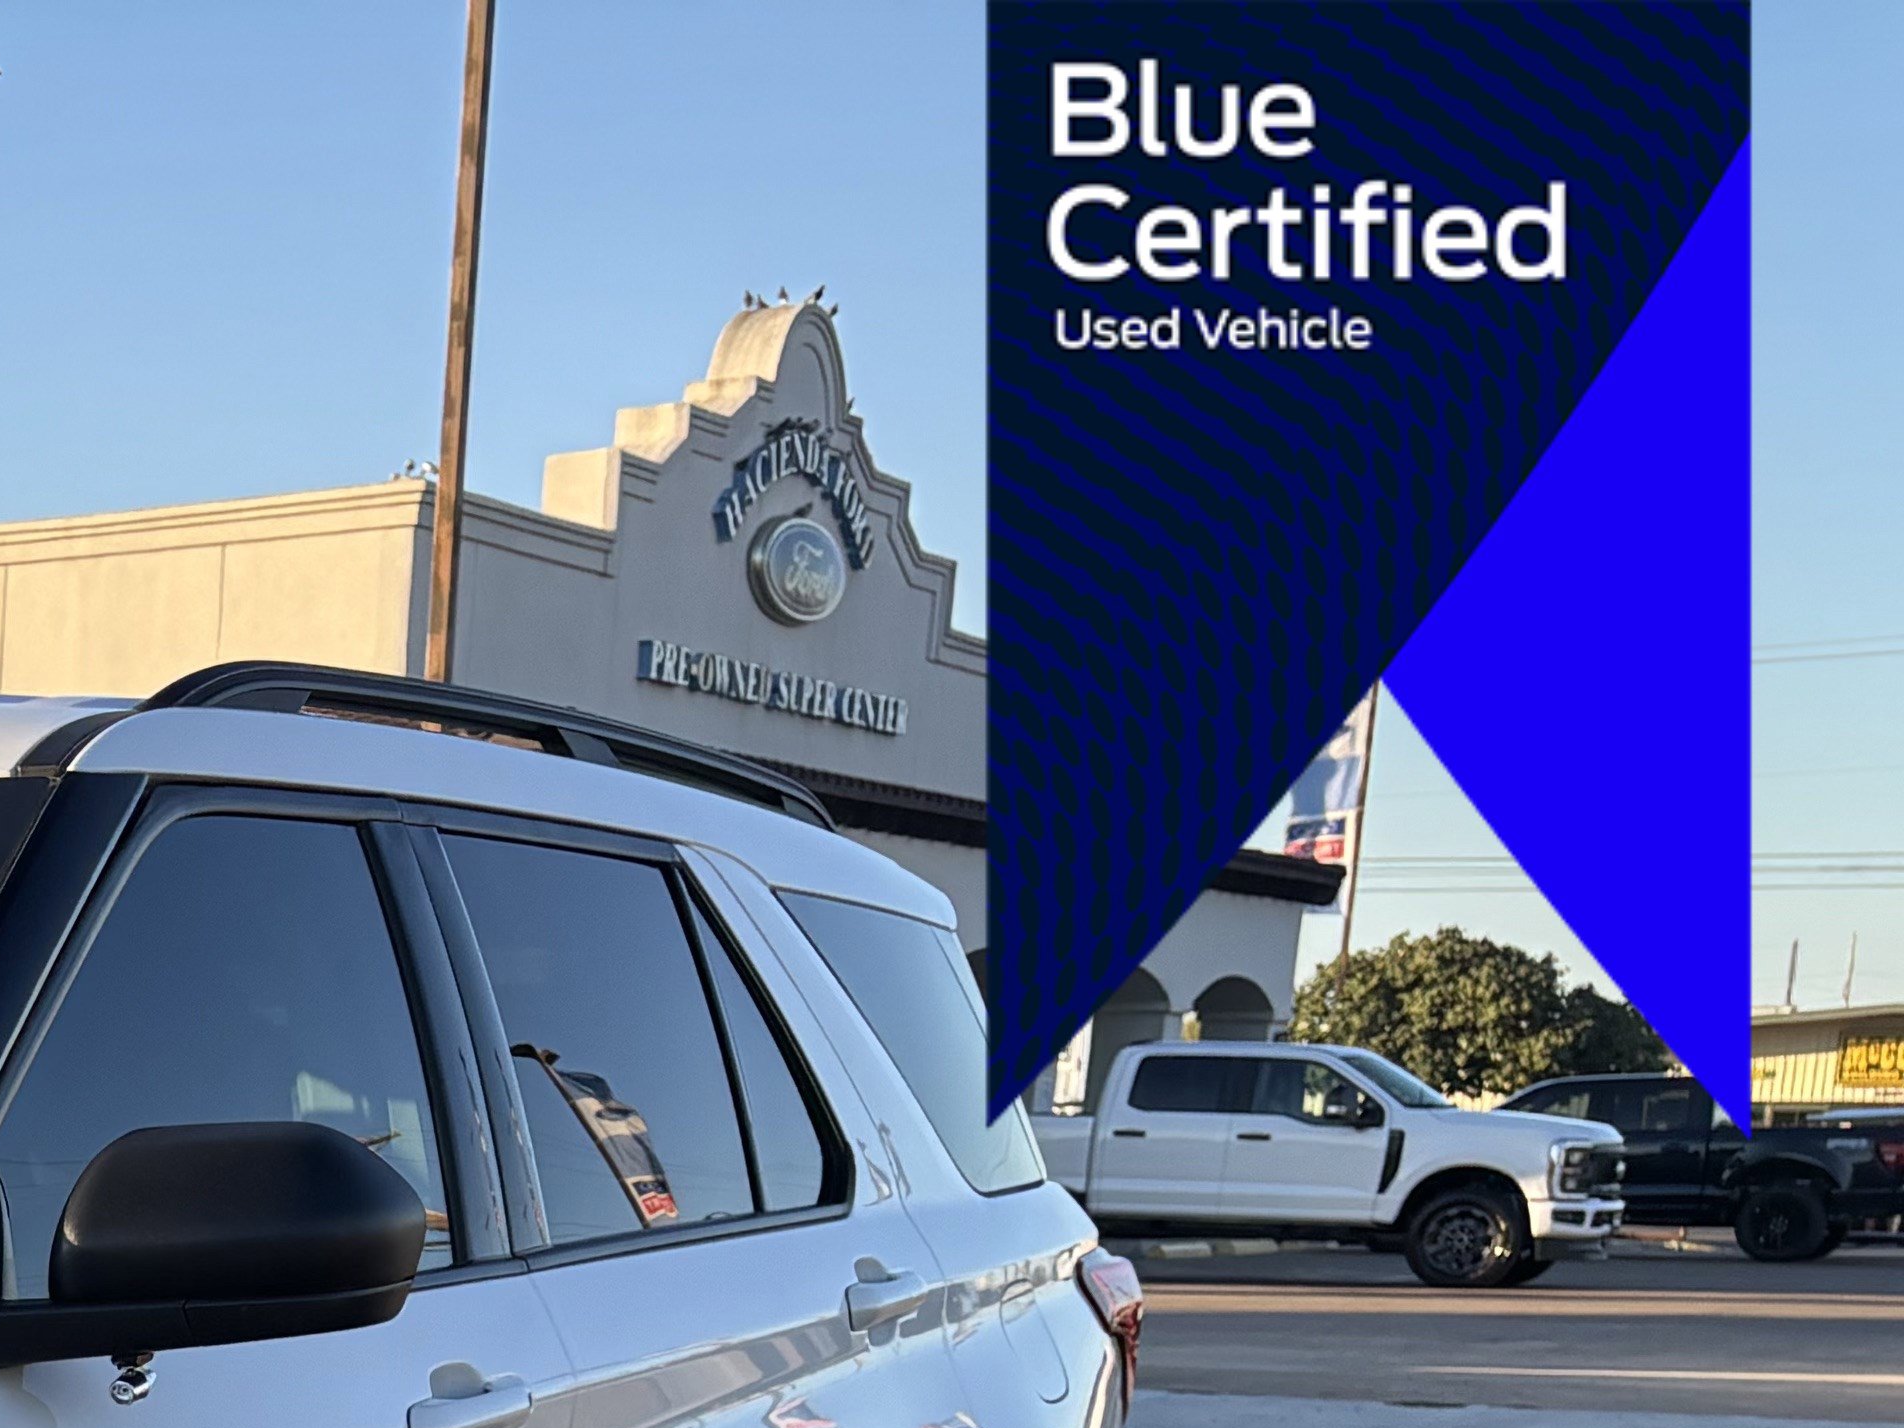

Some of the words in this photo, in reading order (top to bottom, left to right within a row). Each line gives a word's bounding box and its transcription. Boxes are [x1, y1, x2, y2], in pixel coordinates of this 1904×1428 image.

[724, 431, 837, 538] HACIENDA
[648, 639, 773, 704] PRE-OWNED
[775, 671, 837, 720] SUPER
[842, 686, 909, 736] CENTER
